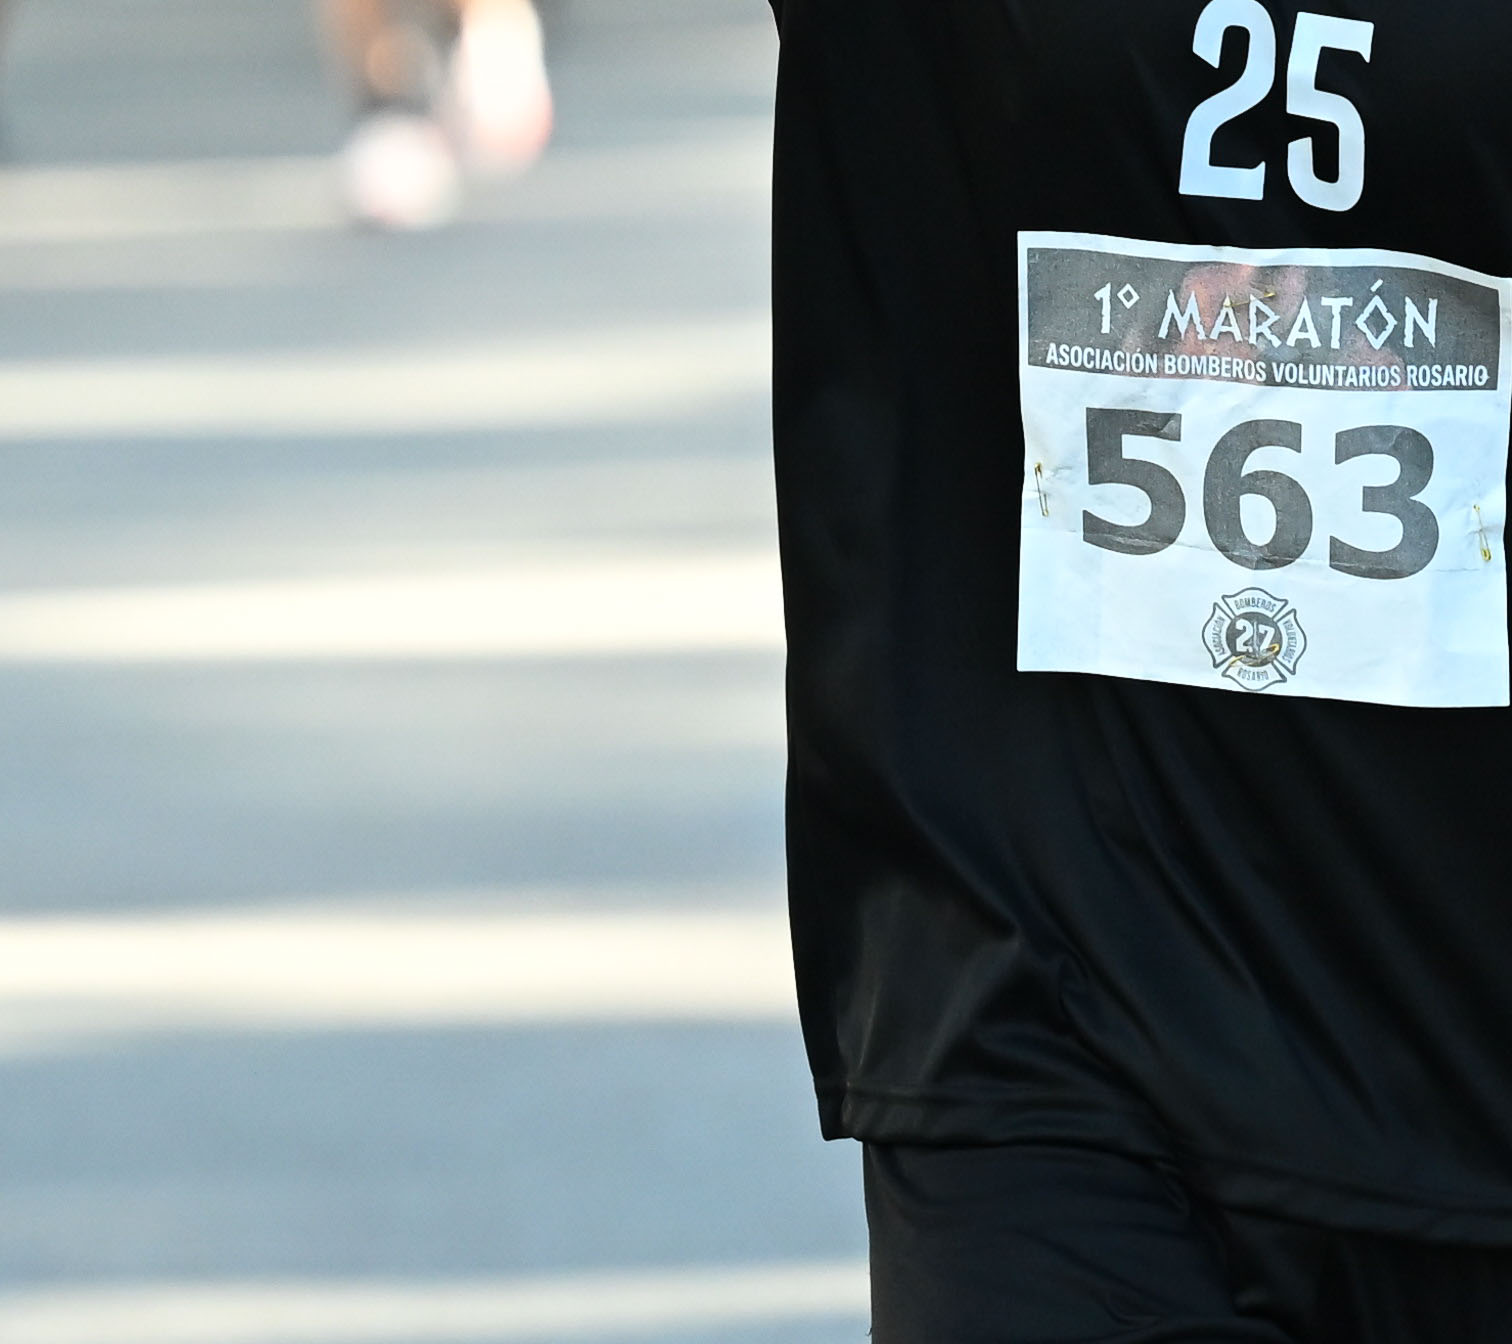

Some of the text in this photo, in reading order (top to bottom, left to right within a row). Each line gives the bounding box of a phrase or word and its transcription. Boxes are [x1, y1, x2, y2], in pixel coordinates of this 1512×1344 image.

[1157, 278, 1439, 351] MARATÓN
[1046, 342, 1489, 388] ASOCIACIÓN BOMBEROS VOLUNTARIOS ROSARIO
[1081, 406, 1441, 581] 563
[1234, 597, 1276, 613] BOMBEROS
[1235, 617, 1275, 655] 27
